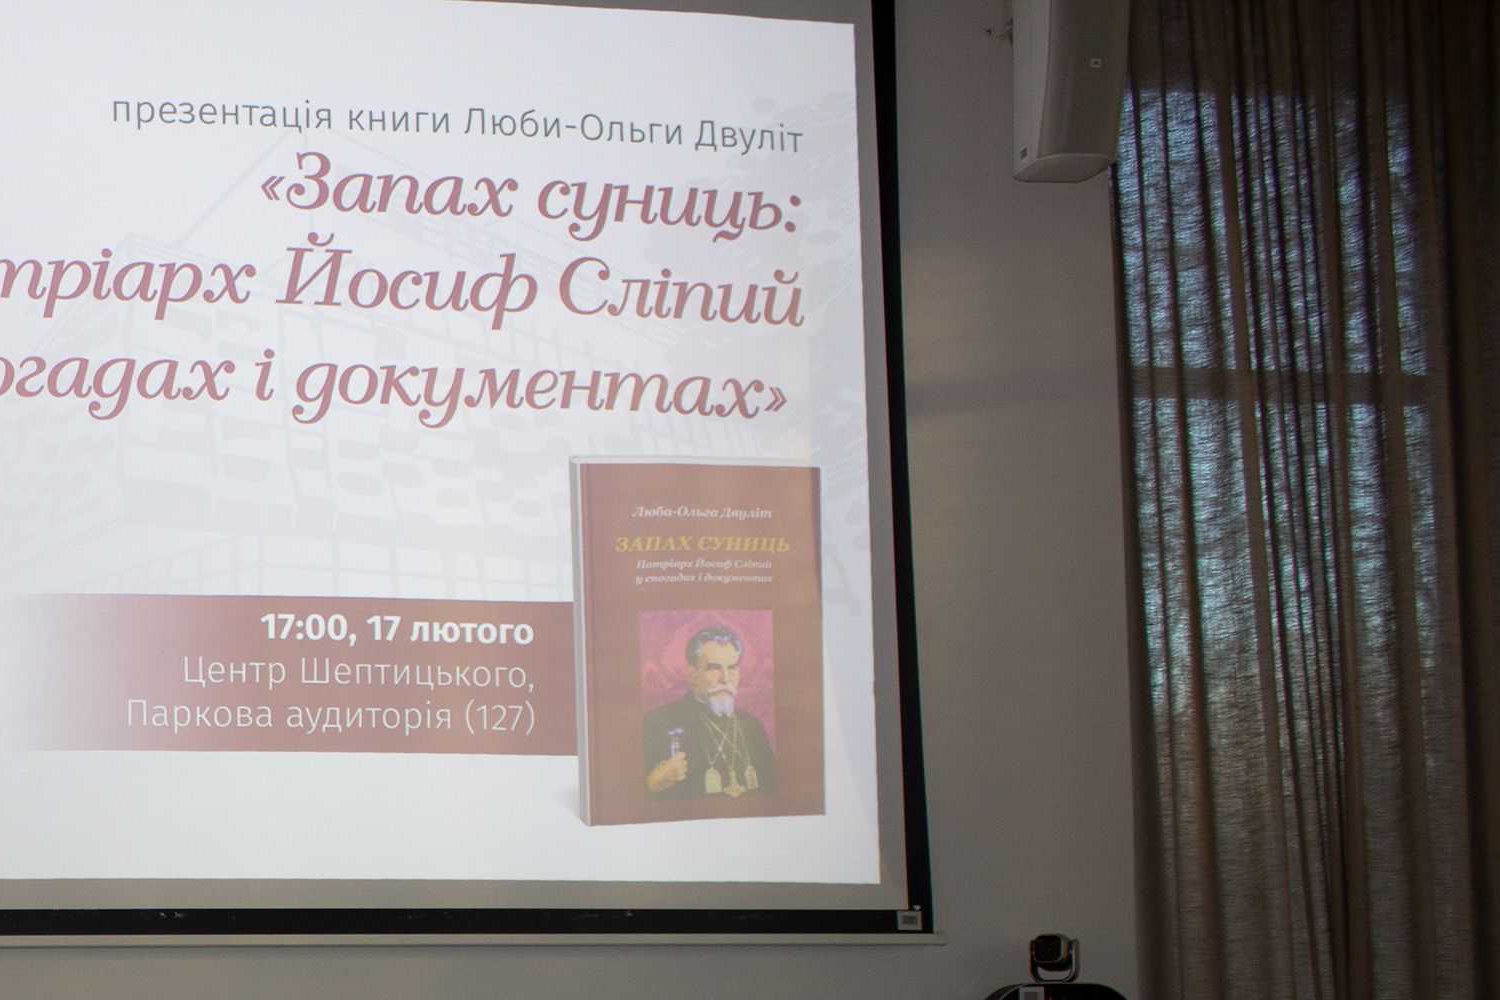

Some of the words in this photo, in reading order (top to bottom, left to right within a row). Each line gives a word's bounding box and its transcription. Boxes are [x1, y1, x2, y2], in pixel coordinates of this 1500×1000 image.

[112, 100, 332, 133] презентація
[348, 108, 450, 134] книги
[464, 107, 683, 145] Люби-Ольги
[695, 119, 804, 156] Двуліт
[261, 151, 518, 217] «Запах
[538, 179, 802, 243] суниць:
[276, 231, 538, 331] Йосиф
[558, 257, 806, 328] Сліпий
[255, 348, 276, 401] і
[291, 361, 788, 429] документах»
[632, 505, 718, 519] Люба-Ольга
[615, 536, 694, 552] ЗАПАХ
[697, 536, 791, 553] СУНИЦЬ
[260, 613, 358, 647] 17:00,
[366, 615, 402, 642] 17
[410, 619, 534, 645] лютого
[183, 656, 286, 689] Центр
[300, 657, 536, 693] Шептицького,
[127, 699, 273, 734] Паркова
[287, 703, 452, 736] аудиторія
[465, 700, 536, 737] (127)
